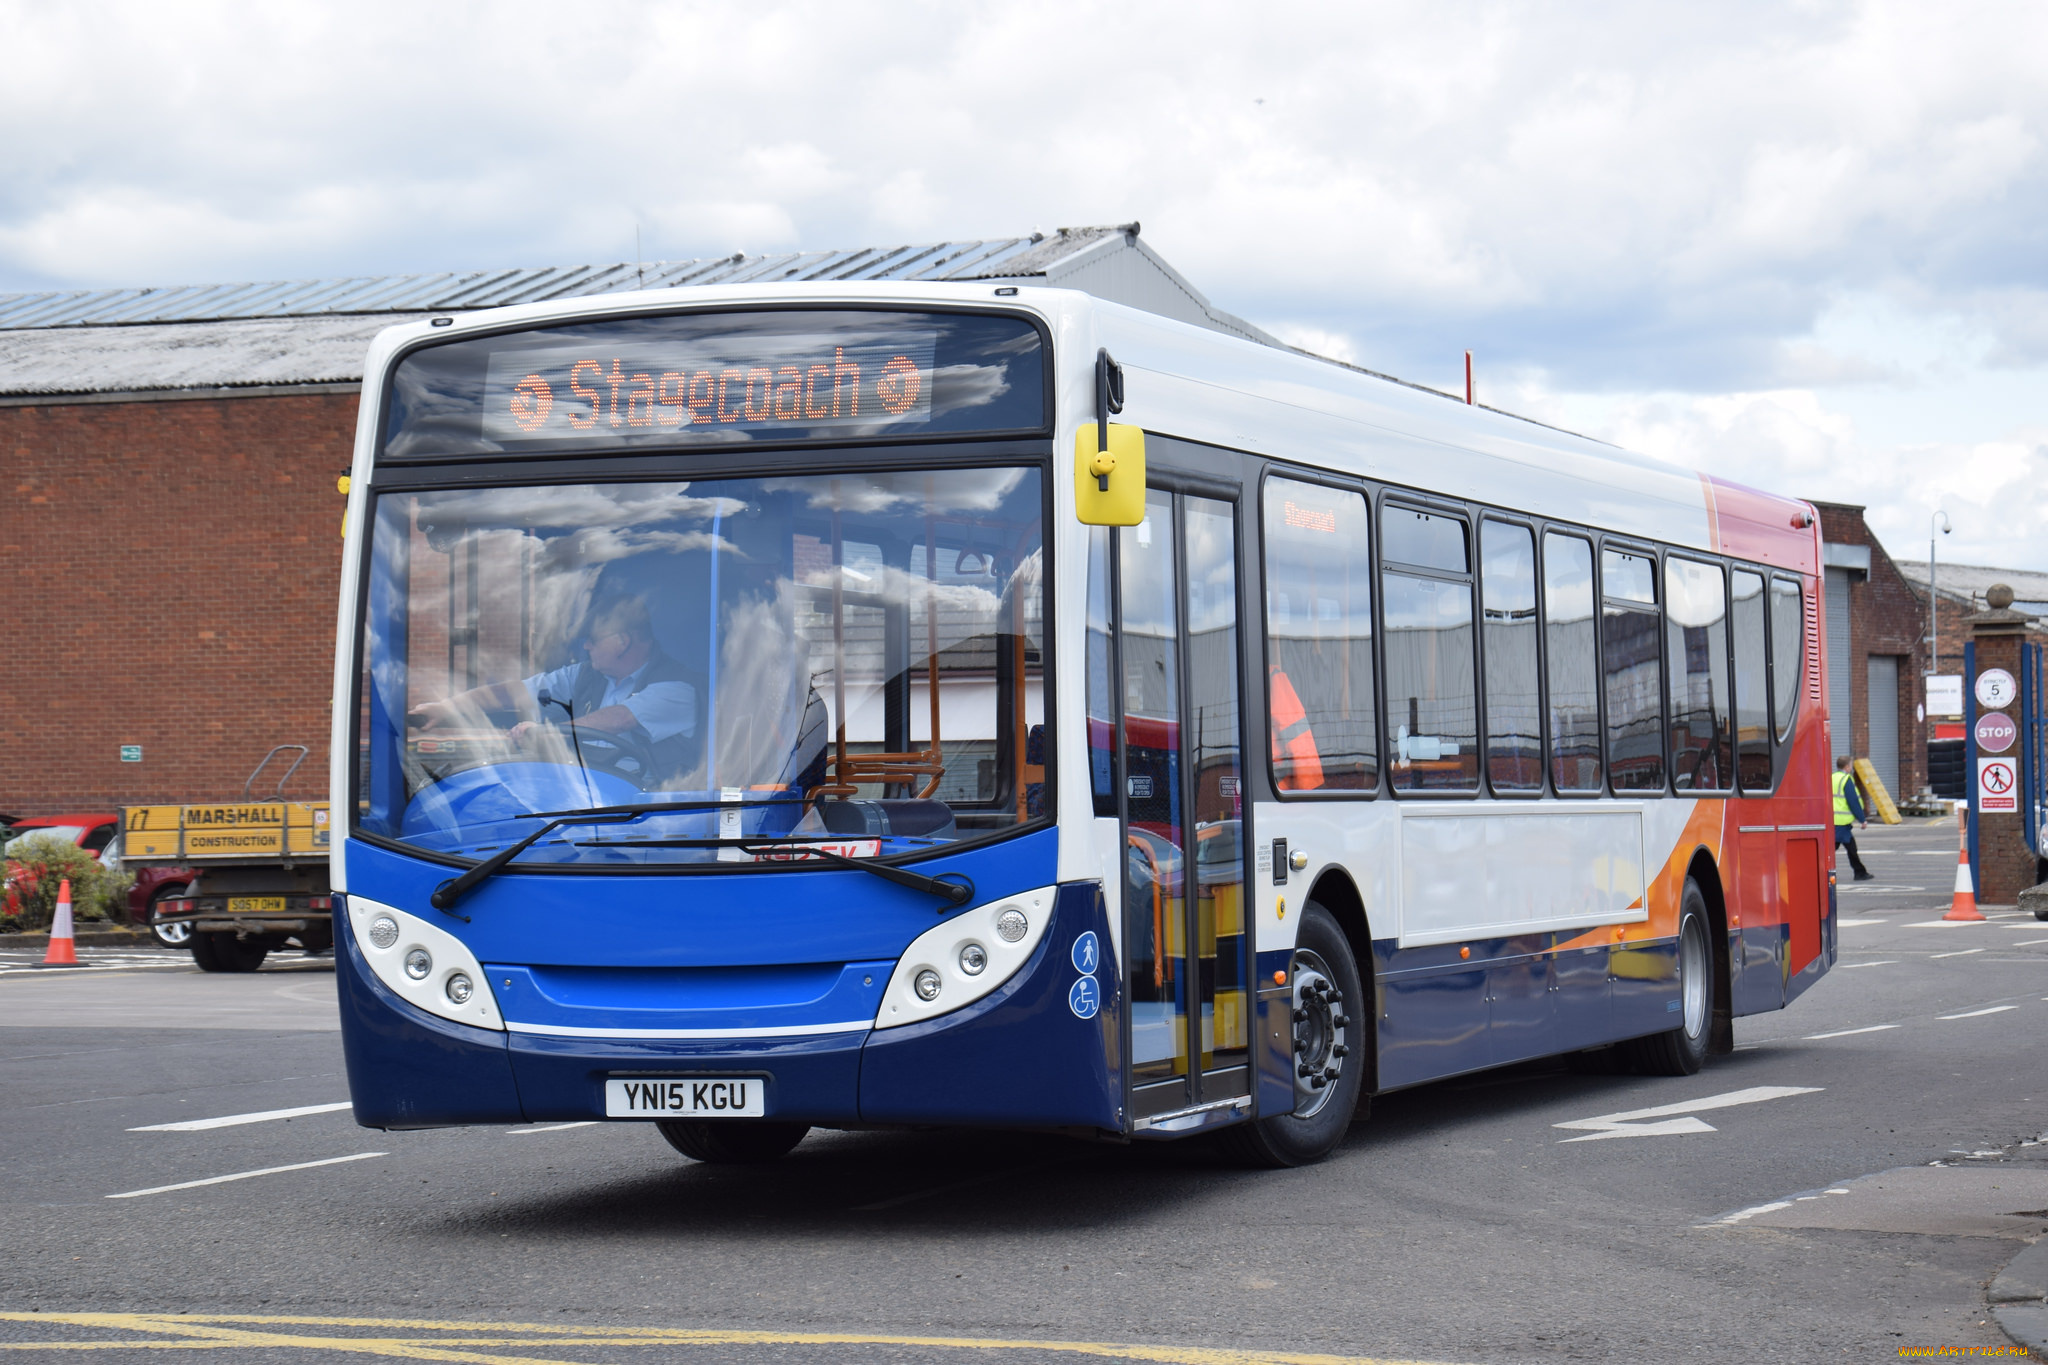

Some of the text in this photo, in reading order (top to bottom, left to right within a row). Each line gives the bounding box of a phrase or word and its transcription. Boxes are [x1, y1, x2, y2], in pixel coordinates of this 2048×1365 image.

[568, 347, 861, 430] Stagecoach
[1991, 684, 2000, 696] 5
[1979, 727, 2013, 738] STOP
[187, 808, 281, 825] MARSHALL
[727, 812, 735, 824] F
[191, 836, 277, 847] CONSTRUCTION
[624, 1083, 746, 1110] YN15 KGU
